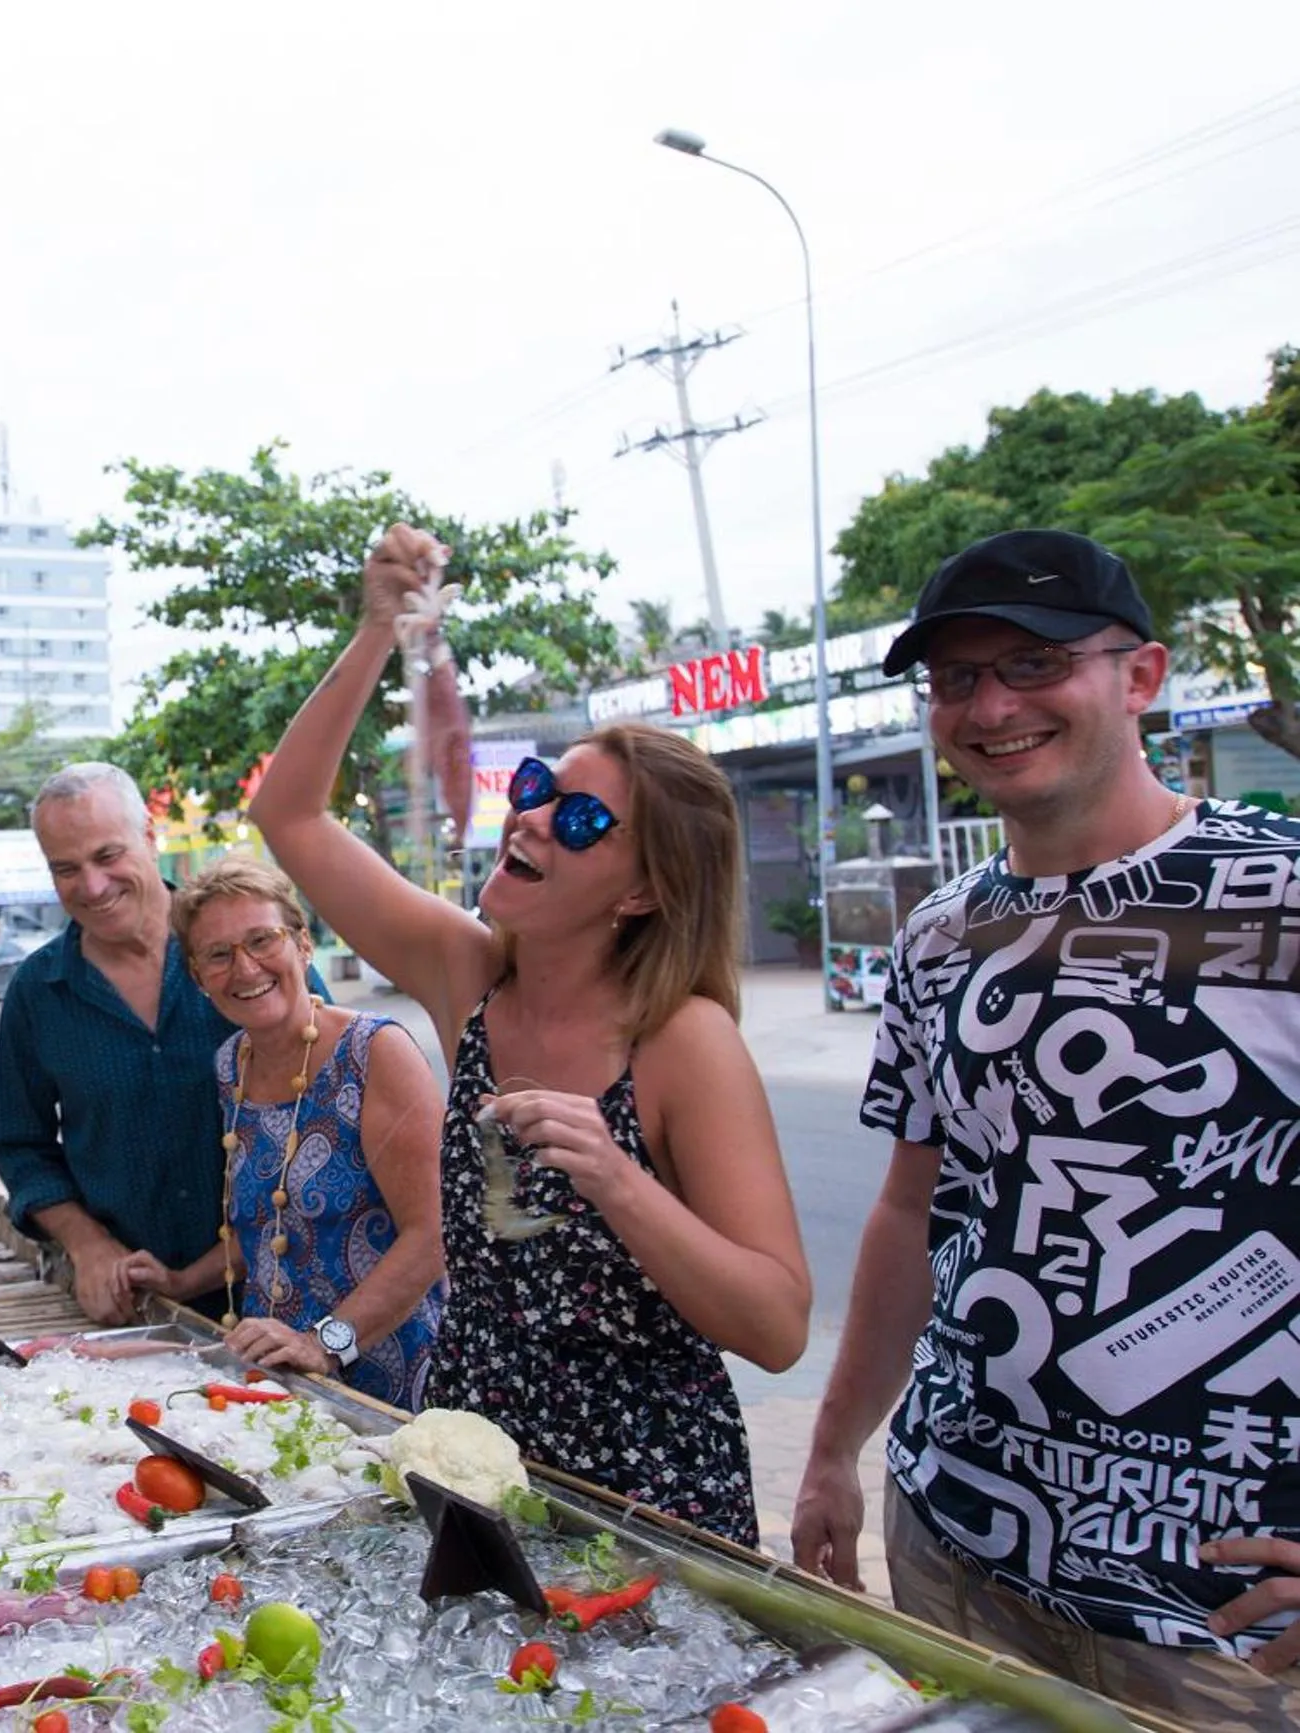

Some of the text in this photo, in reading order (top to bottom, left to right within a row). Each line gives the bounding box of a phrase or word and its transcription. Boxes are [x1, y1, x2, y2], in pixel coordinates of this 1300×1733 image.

[668, 645, 769, 716] NEM
[475, 770, 516, 793] NE
[1203, 853, 1300, 909] 19
[1105, 1247, 1268, 1358] FUTURISTIC YOUTHS
[1075, 1419, 1192, 1458] CROPP
[1002, 1423, 1267, 1528] FUTURISTIC
